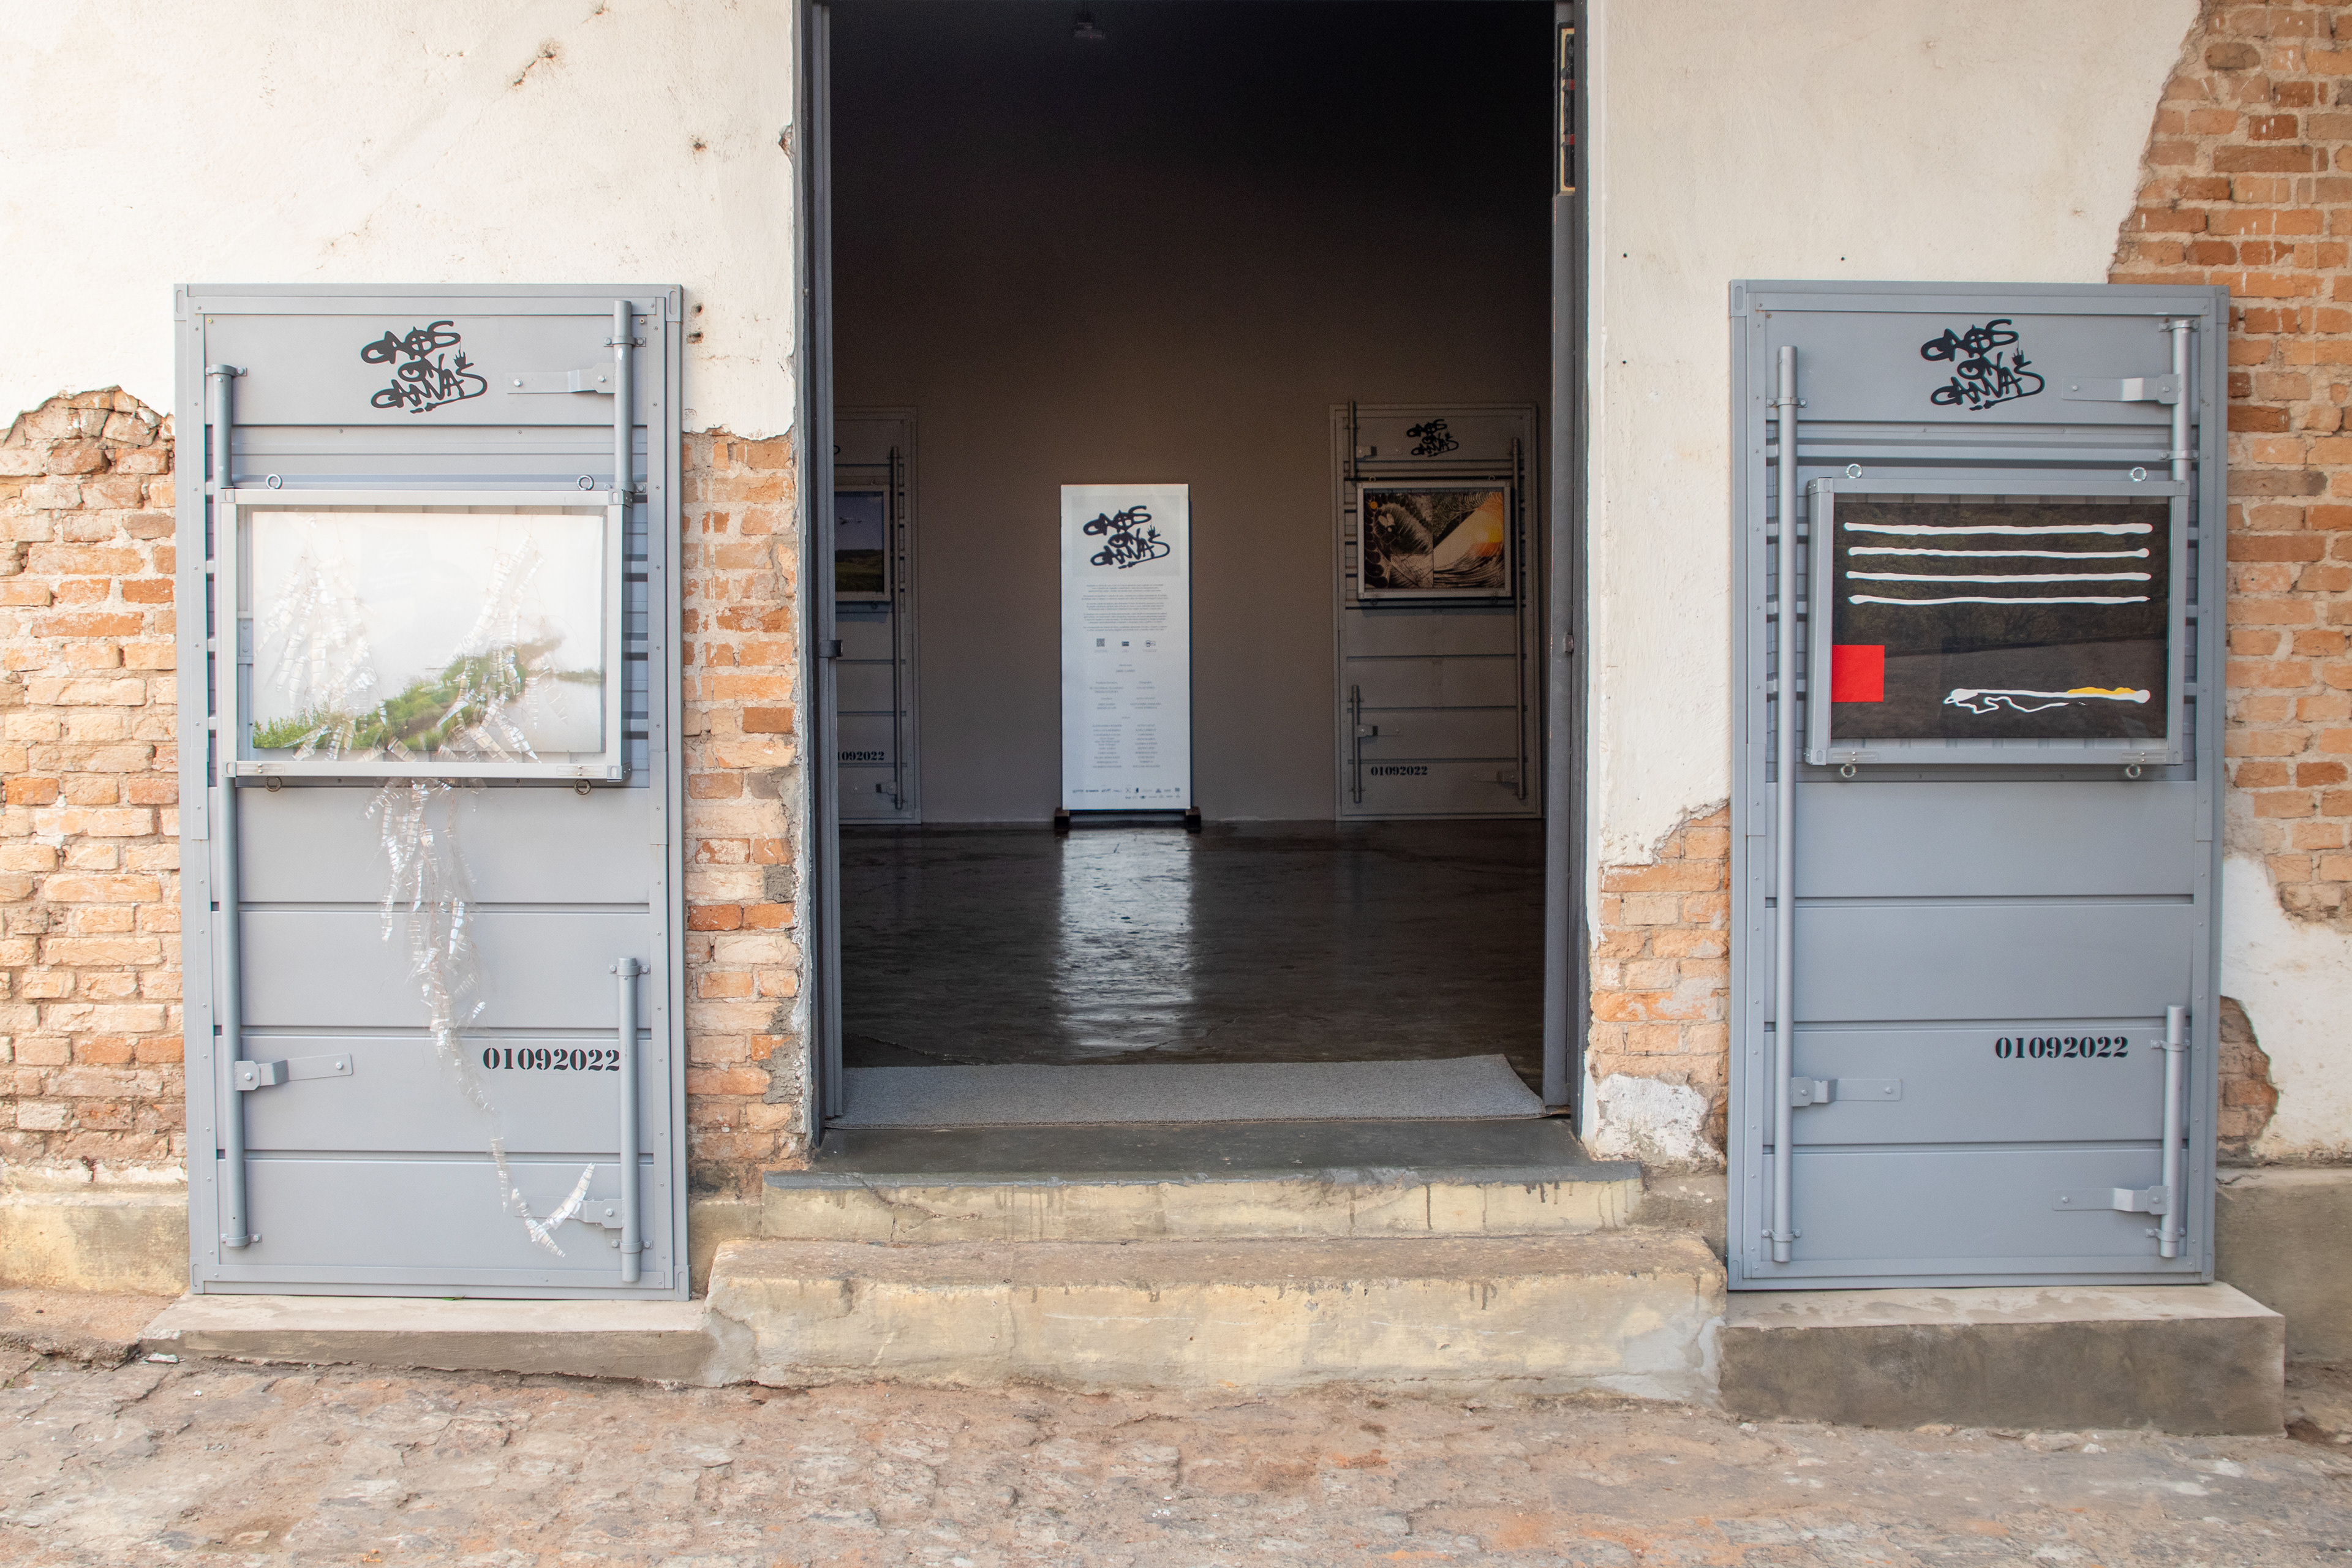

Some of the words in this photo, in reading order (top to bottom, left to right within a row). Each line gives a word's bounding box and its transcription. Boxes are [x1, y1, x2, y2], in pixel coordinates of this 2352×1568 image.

[371, 361, 488, 414] CANVAS
[1930, 360, 2046, 412] CANVAS
[838, 751, 885, 761] 1092022
[1371, 766, 1428, 776] 01092022
[483, 1047, 620, 1071] 01092022
[1994, 1036, 2129, 1059] 01092022
